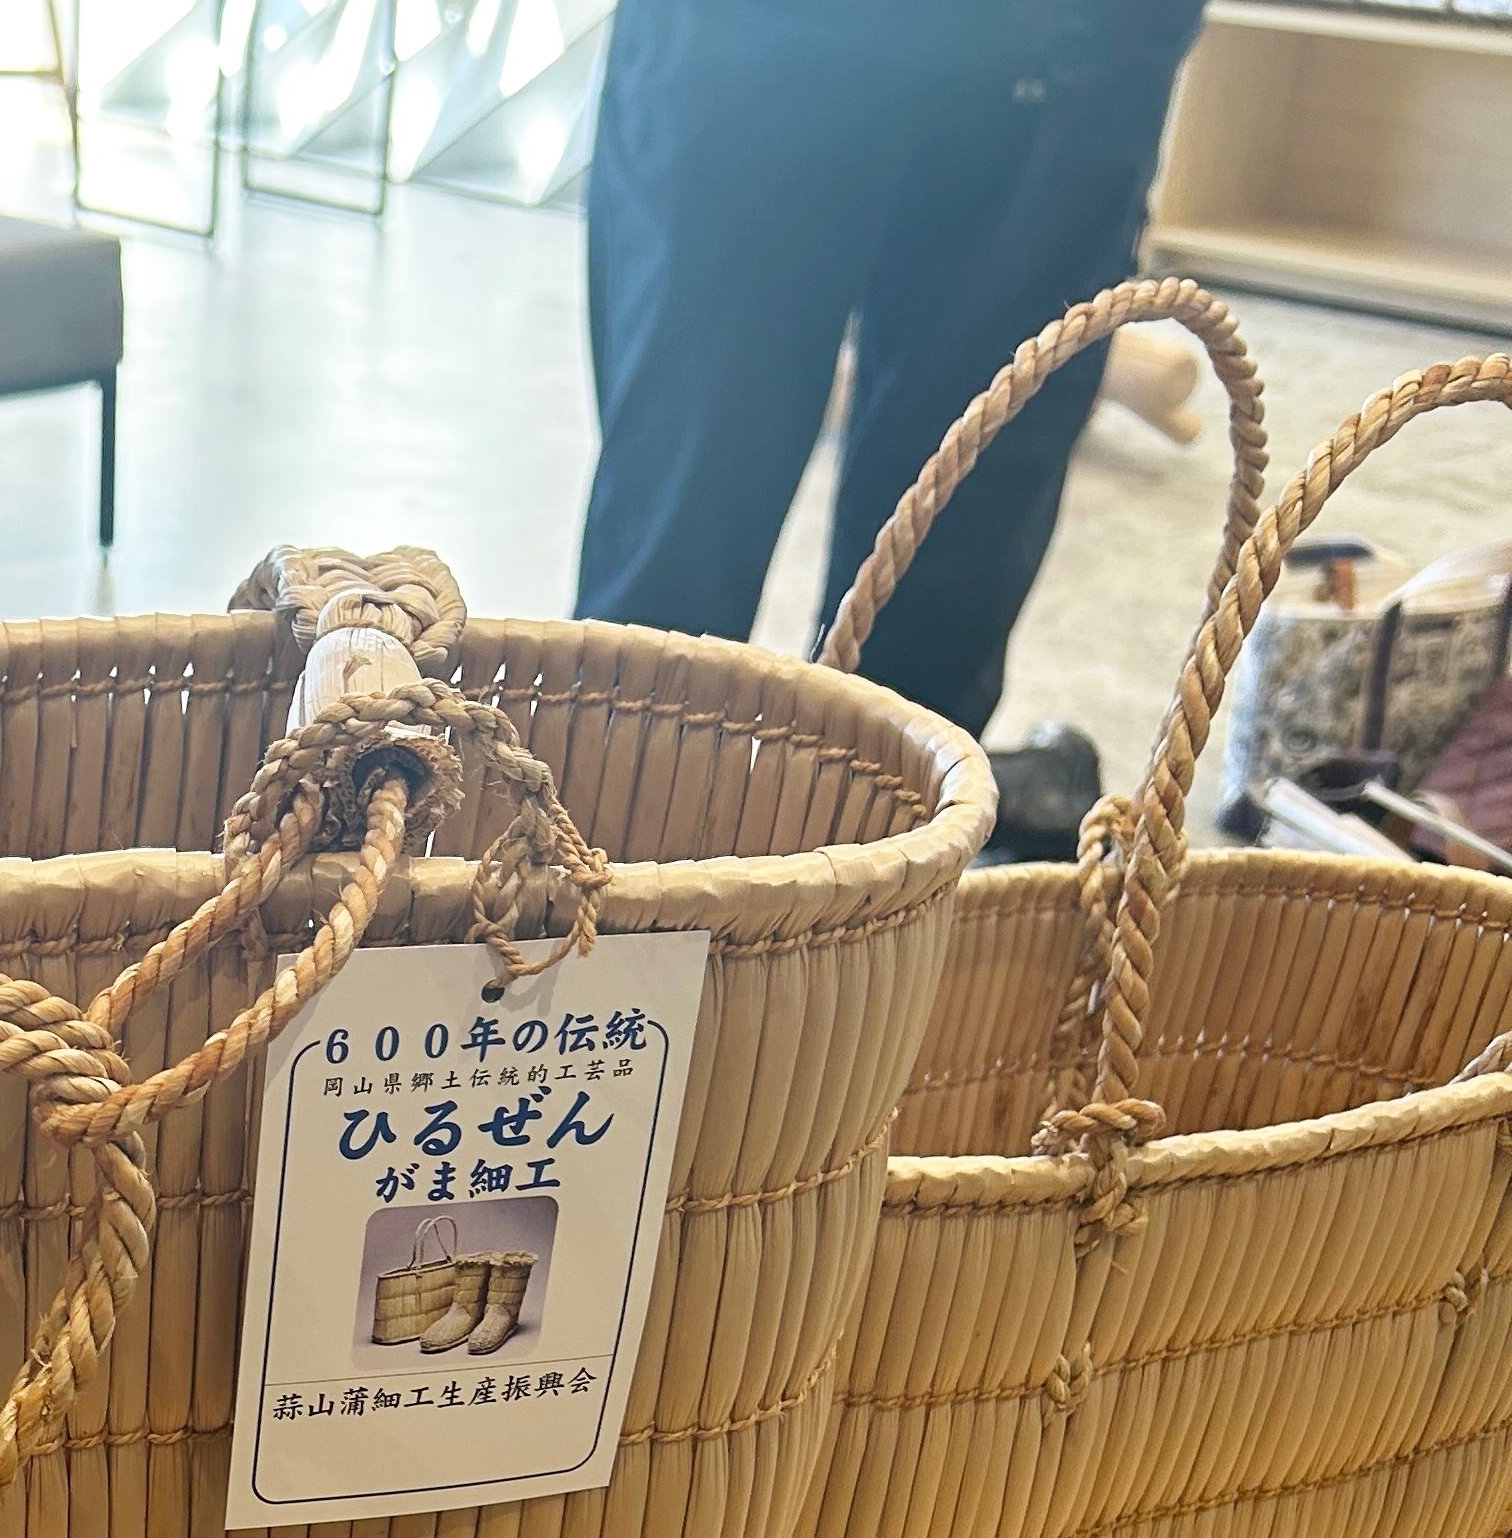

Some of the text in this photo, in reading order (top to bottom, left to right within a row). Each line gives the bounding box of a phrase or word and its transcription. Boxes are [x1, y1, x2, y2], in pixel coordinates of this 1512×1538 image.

[324, 1007, 647, 1064] 600年の伝統
[323, 1058, 634, 1097] 岡山県郷土伝統的工芸品
[338, 1086, 615, 1160] ひるぜん
[375, 1157, 561, 1203] がま細工
[272, 1366, 597, 1421] 蒜山蒲細工生産振興会
